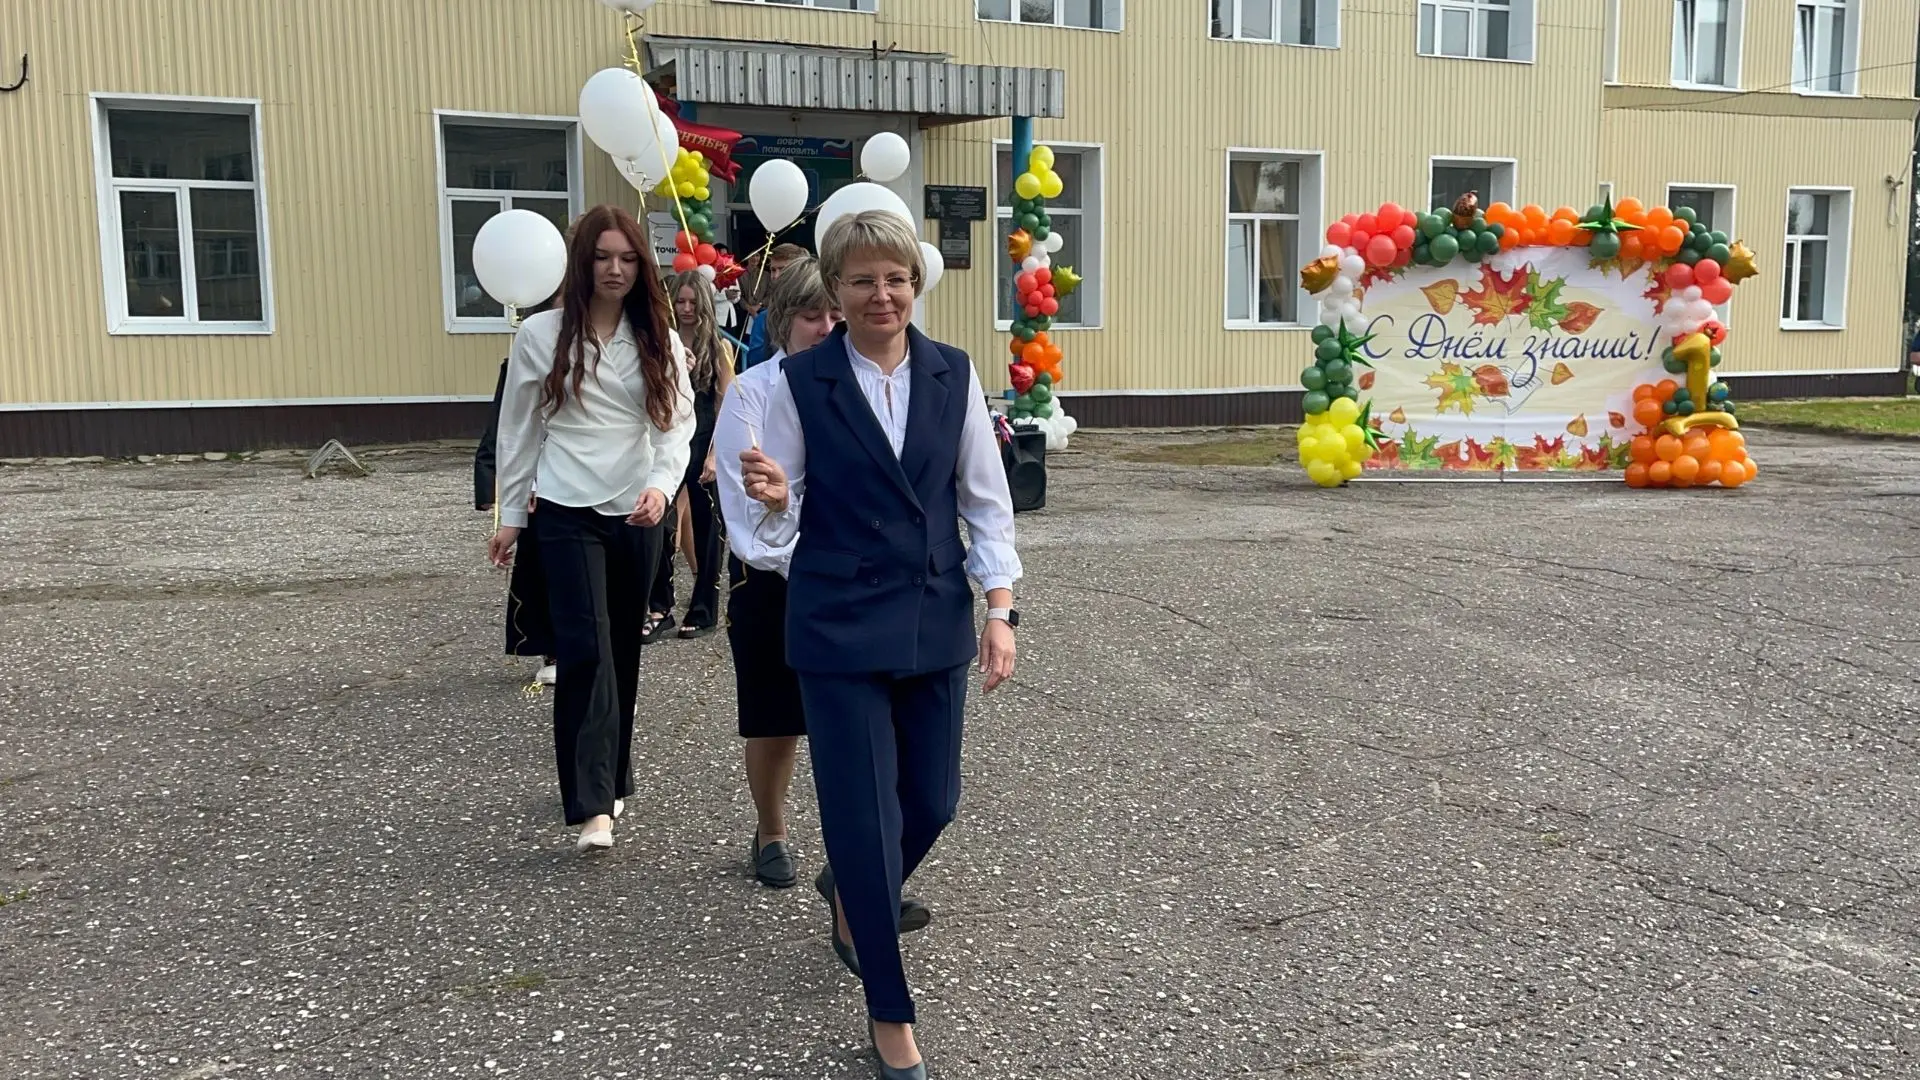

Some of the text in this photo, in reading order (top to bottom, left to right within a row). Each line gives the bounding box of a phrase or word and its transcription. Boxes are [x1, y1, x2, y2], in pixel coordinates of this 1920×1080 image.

[677, 129, 729, 154] НТЯБРЯ
[776, 138, 804, 146] ДОБРО
[762, 146, 819, 156] ПОЖАЛОВАТЬ!
[1363, 313, 1662, 389] С Днём знаний!
